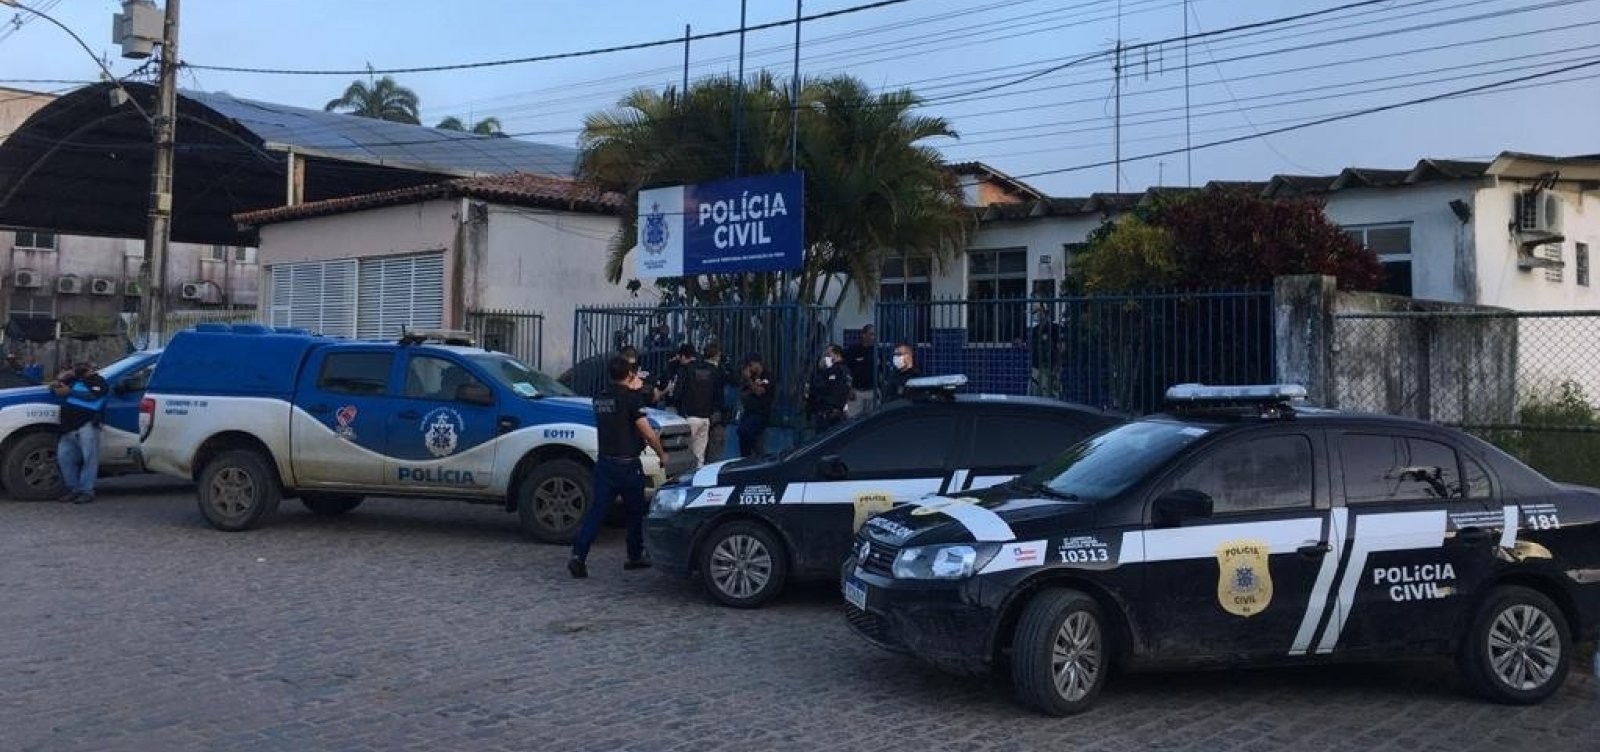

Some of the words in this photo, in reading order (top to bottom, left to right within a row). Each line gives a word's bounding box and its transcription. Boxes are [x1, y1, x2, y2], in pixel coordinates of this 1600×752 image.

[699, 191, 787, 226] POLÍCIA
[714, 221, 772, 249] CIVIL
[398, 466, 475, 484] POLÍCIA
[1528, 514, 1560, 530] 181
[1234, 595, 1256, 604] CIVIL
[1389, 582, 1446, 602] CIVIL
